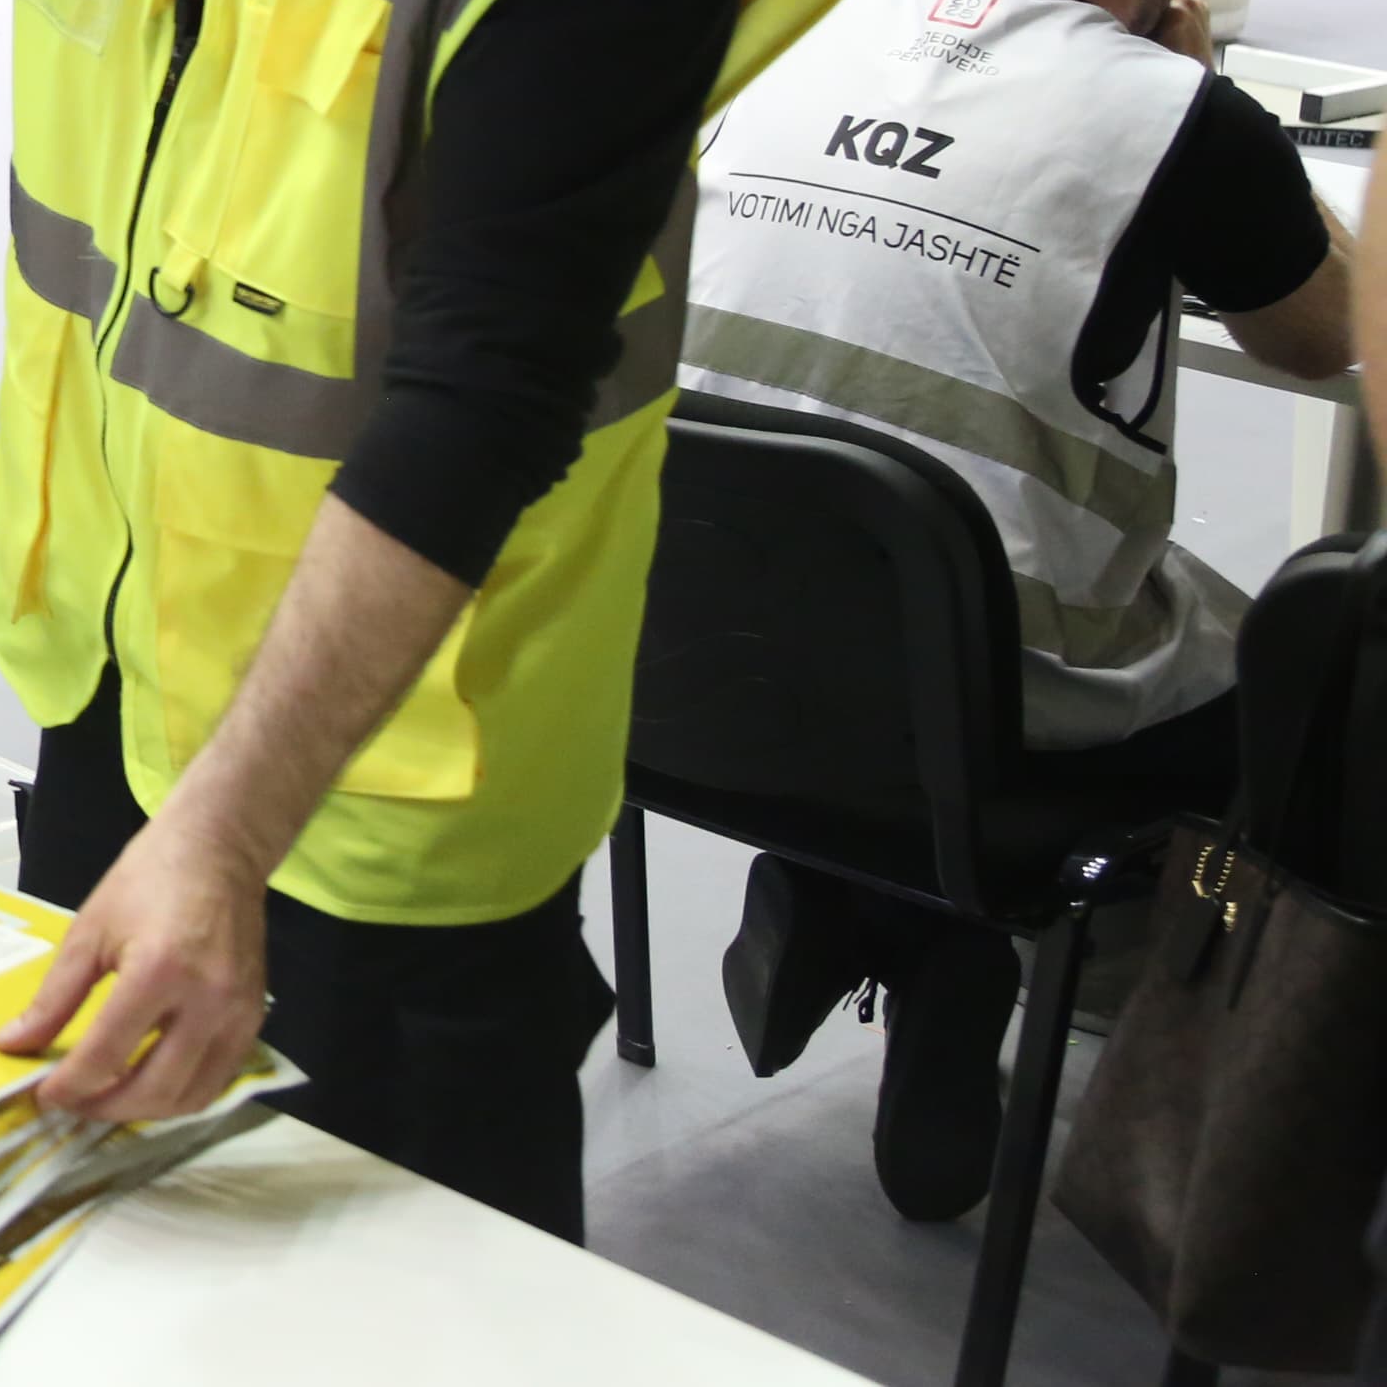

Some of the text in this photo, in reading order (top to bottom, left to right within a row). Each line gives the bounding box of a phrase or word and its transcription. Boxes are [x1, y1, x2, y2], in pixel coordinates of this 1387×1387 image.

[824, 114, 955, 180] KQZ
[727, 190, 1021, 289] VOTIMI NGA JASHTË
